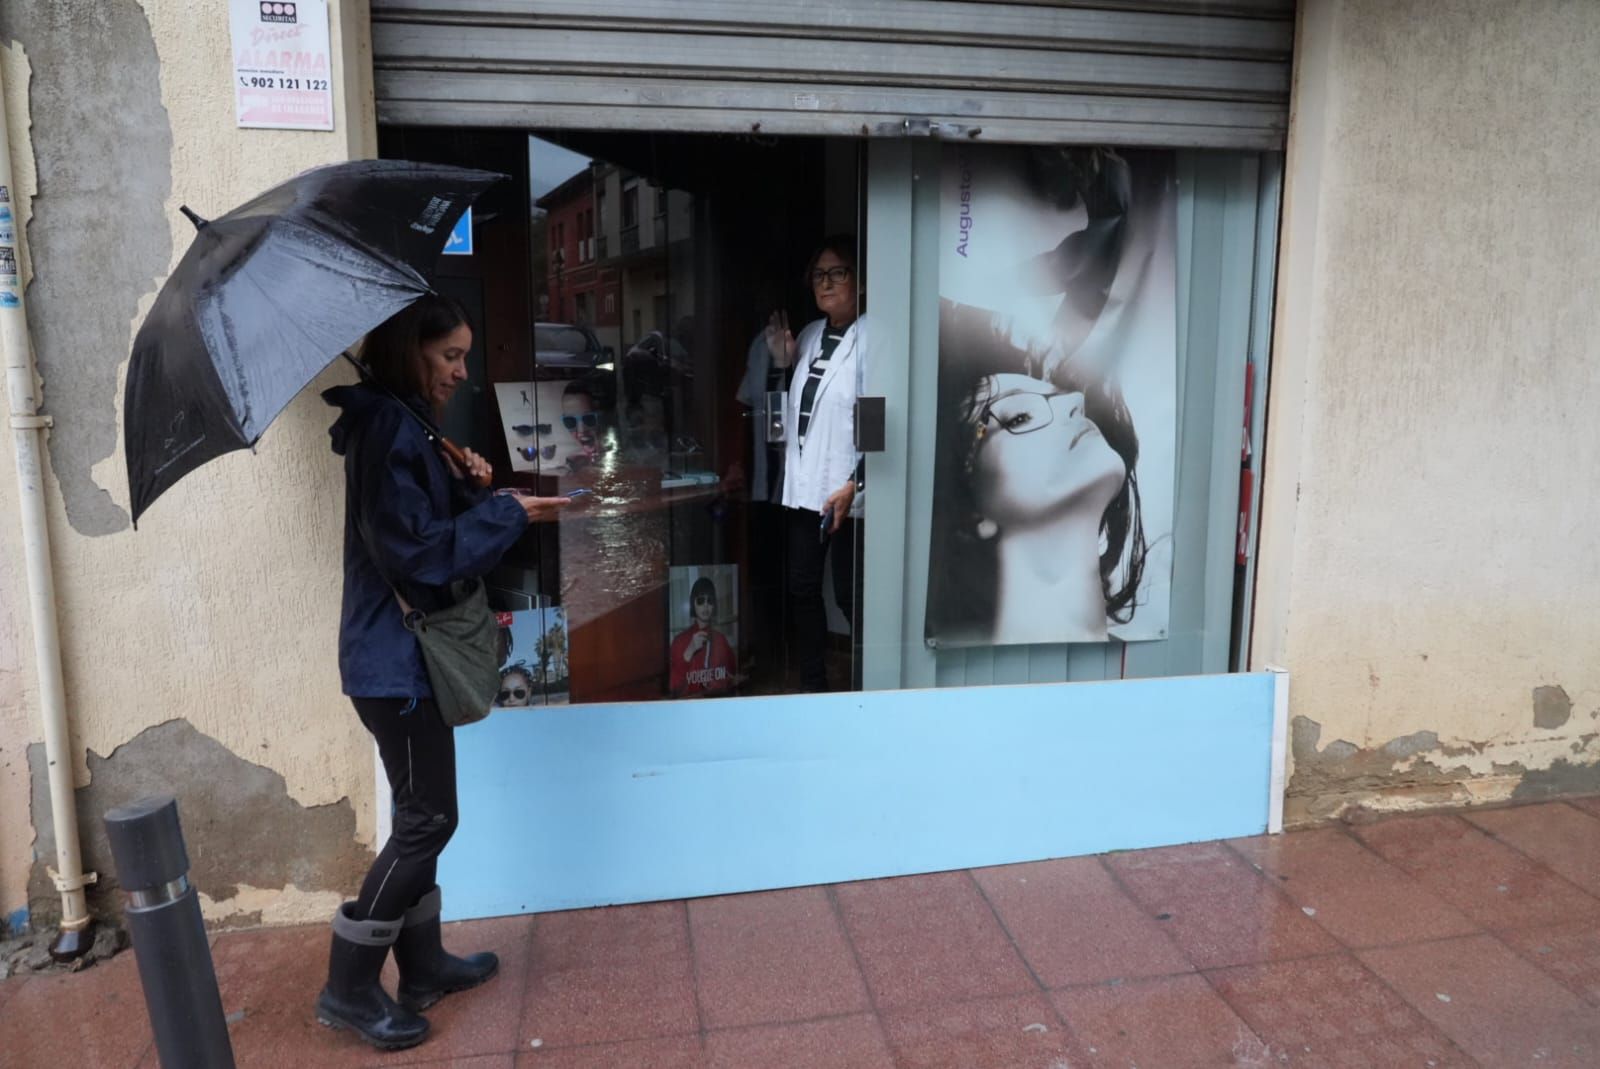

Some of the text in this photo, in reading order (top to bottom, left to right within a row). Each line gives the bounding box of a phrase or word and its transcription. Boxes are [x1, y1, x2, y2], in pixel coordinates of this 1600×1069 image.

[238, 49, 325, 69] ALARMA
[251, 77, 328, 91] 902 121 122
